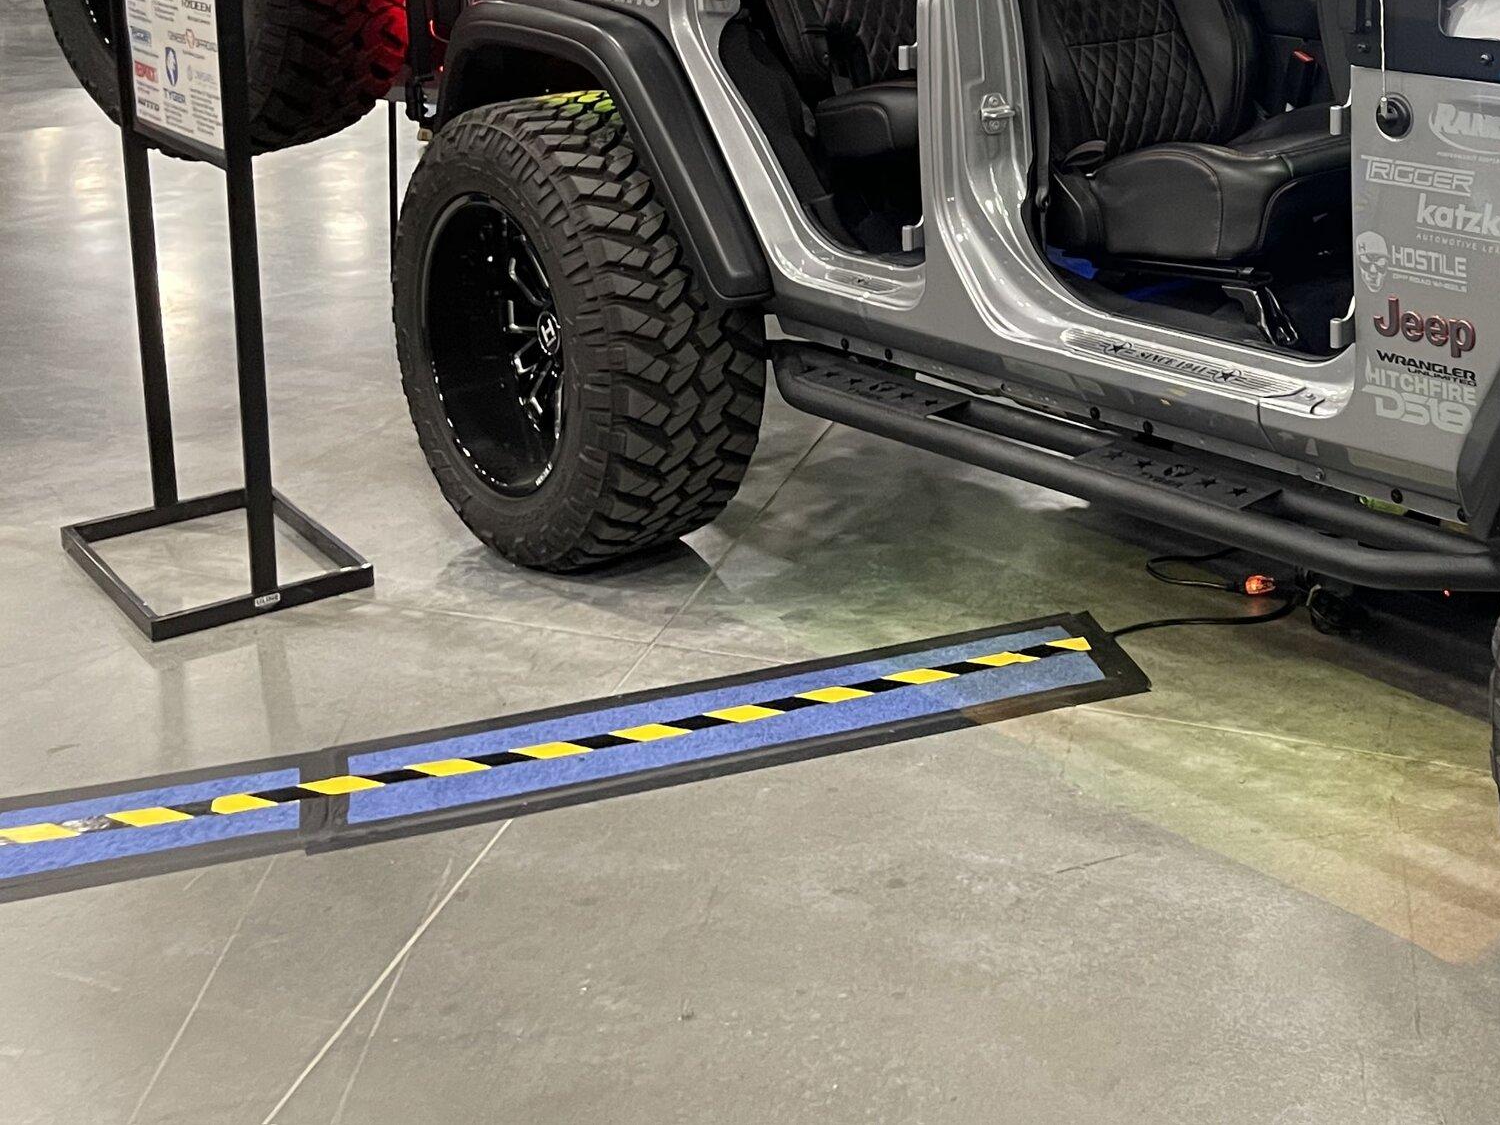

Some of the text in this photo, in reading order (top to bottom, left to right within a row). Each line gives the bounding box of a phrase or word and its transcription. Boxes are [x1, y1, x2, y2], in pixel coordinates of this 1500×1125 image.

[1361, 155, 1475, 194] TRIGGER
[1415, 233, 1478, 252] AUTOMOTIVE
[1392, 245, 1467, 278] HOSTILE
[1410, 276, 1432, 286] ROAD
[1373, 295, 1476, 358] Jeep
[1137, 350, 1176, 366] SINCE
[1376, 349, 1477, 381] WRANGLER
[1366, 362, 1477, 405] HITCHFIRE
[1408, 367, 1477, 387] UNLIMITED
